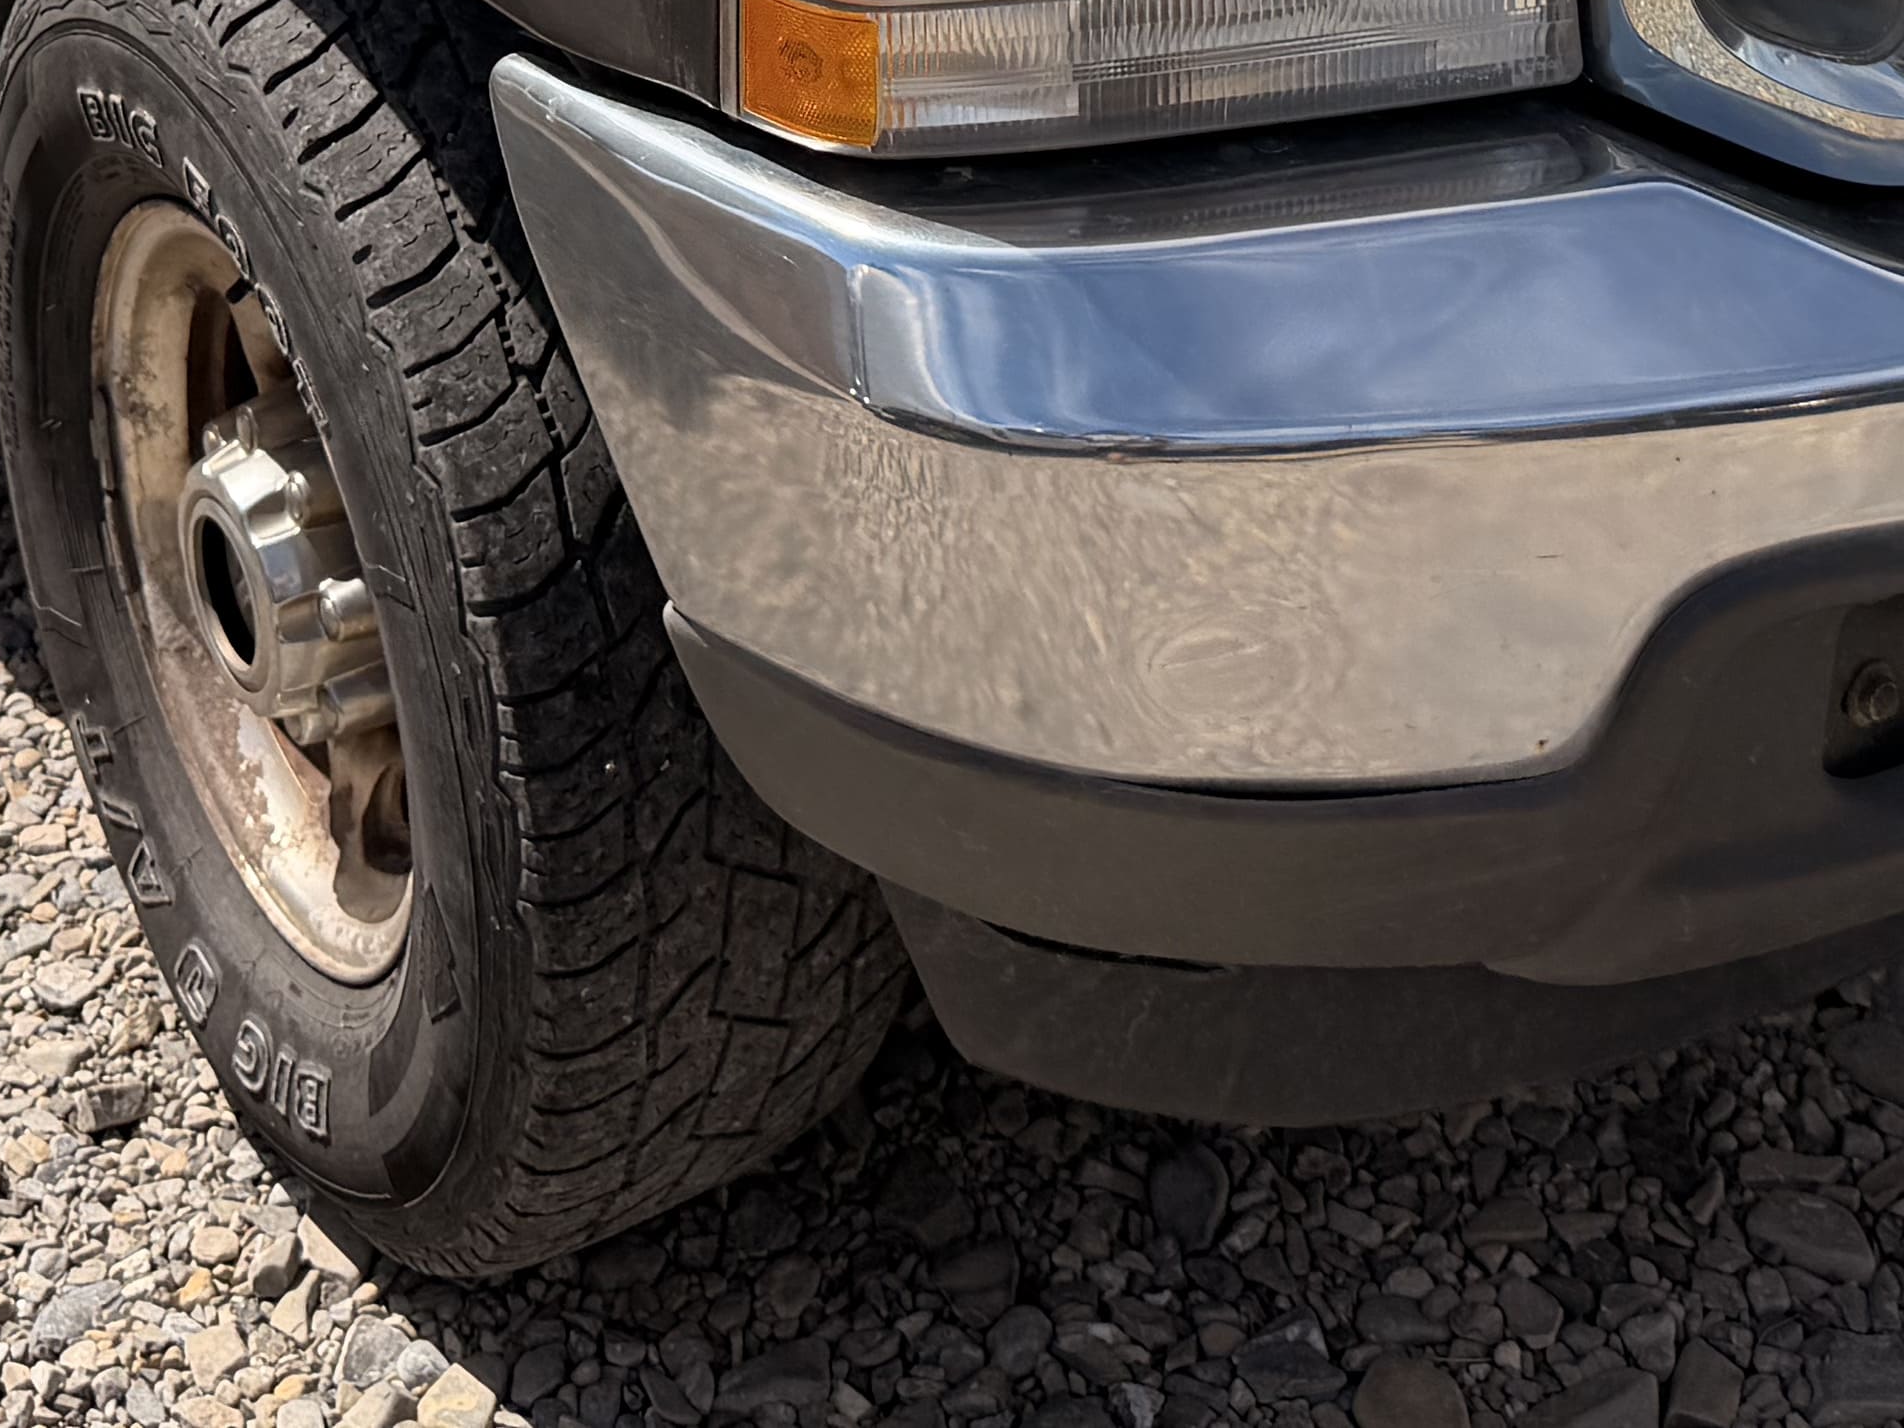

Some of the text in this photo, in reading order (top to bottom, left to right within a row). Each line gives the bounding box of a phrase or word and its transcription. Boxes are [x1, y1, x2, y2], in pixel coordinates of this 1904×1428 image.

[77, 86, 329, 427] BIG FOOT
[231, 1015, 332, 1147] BIG
